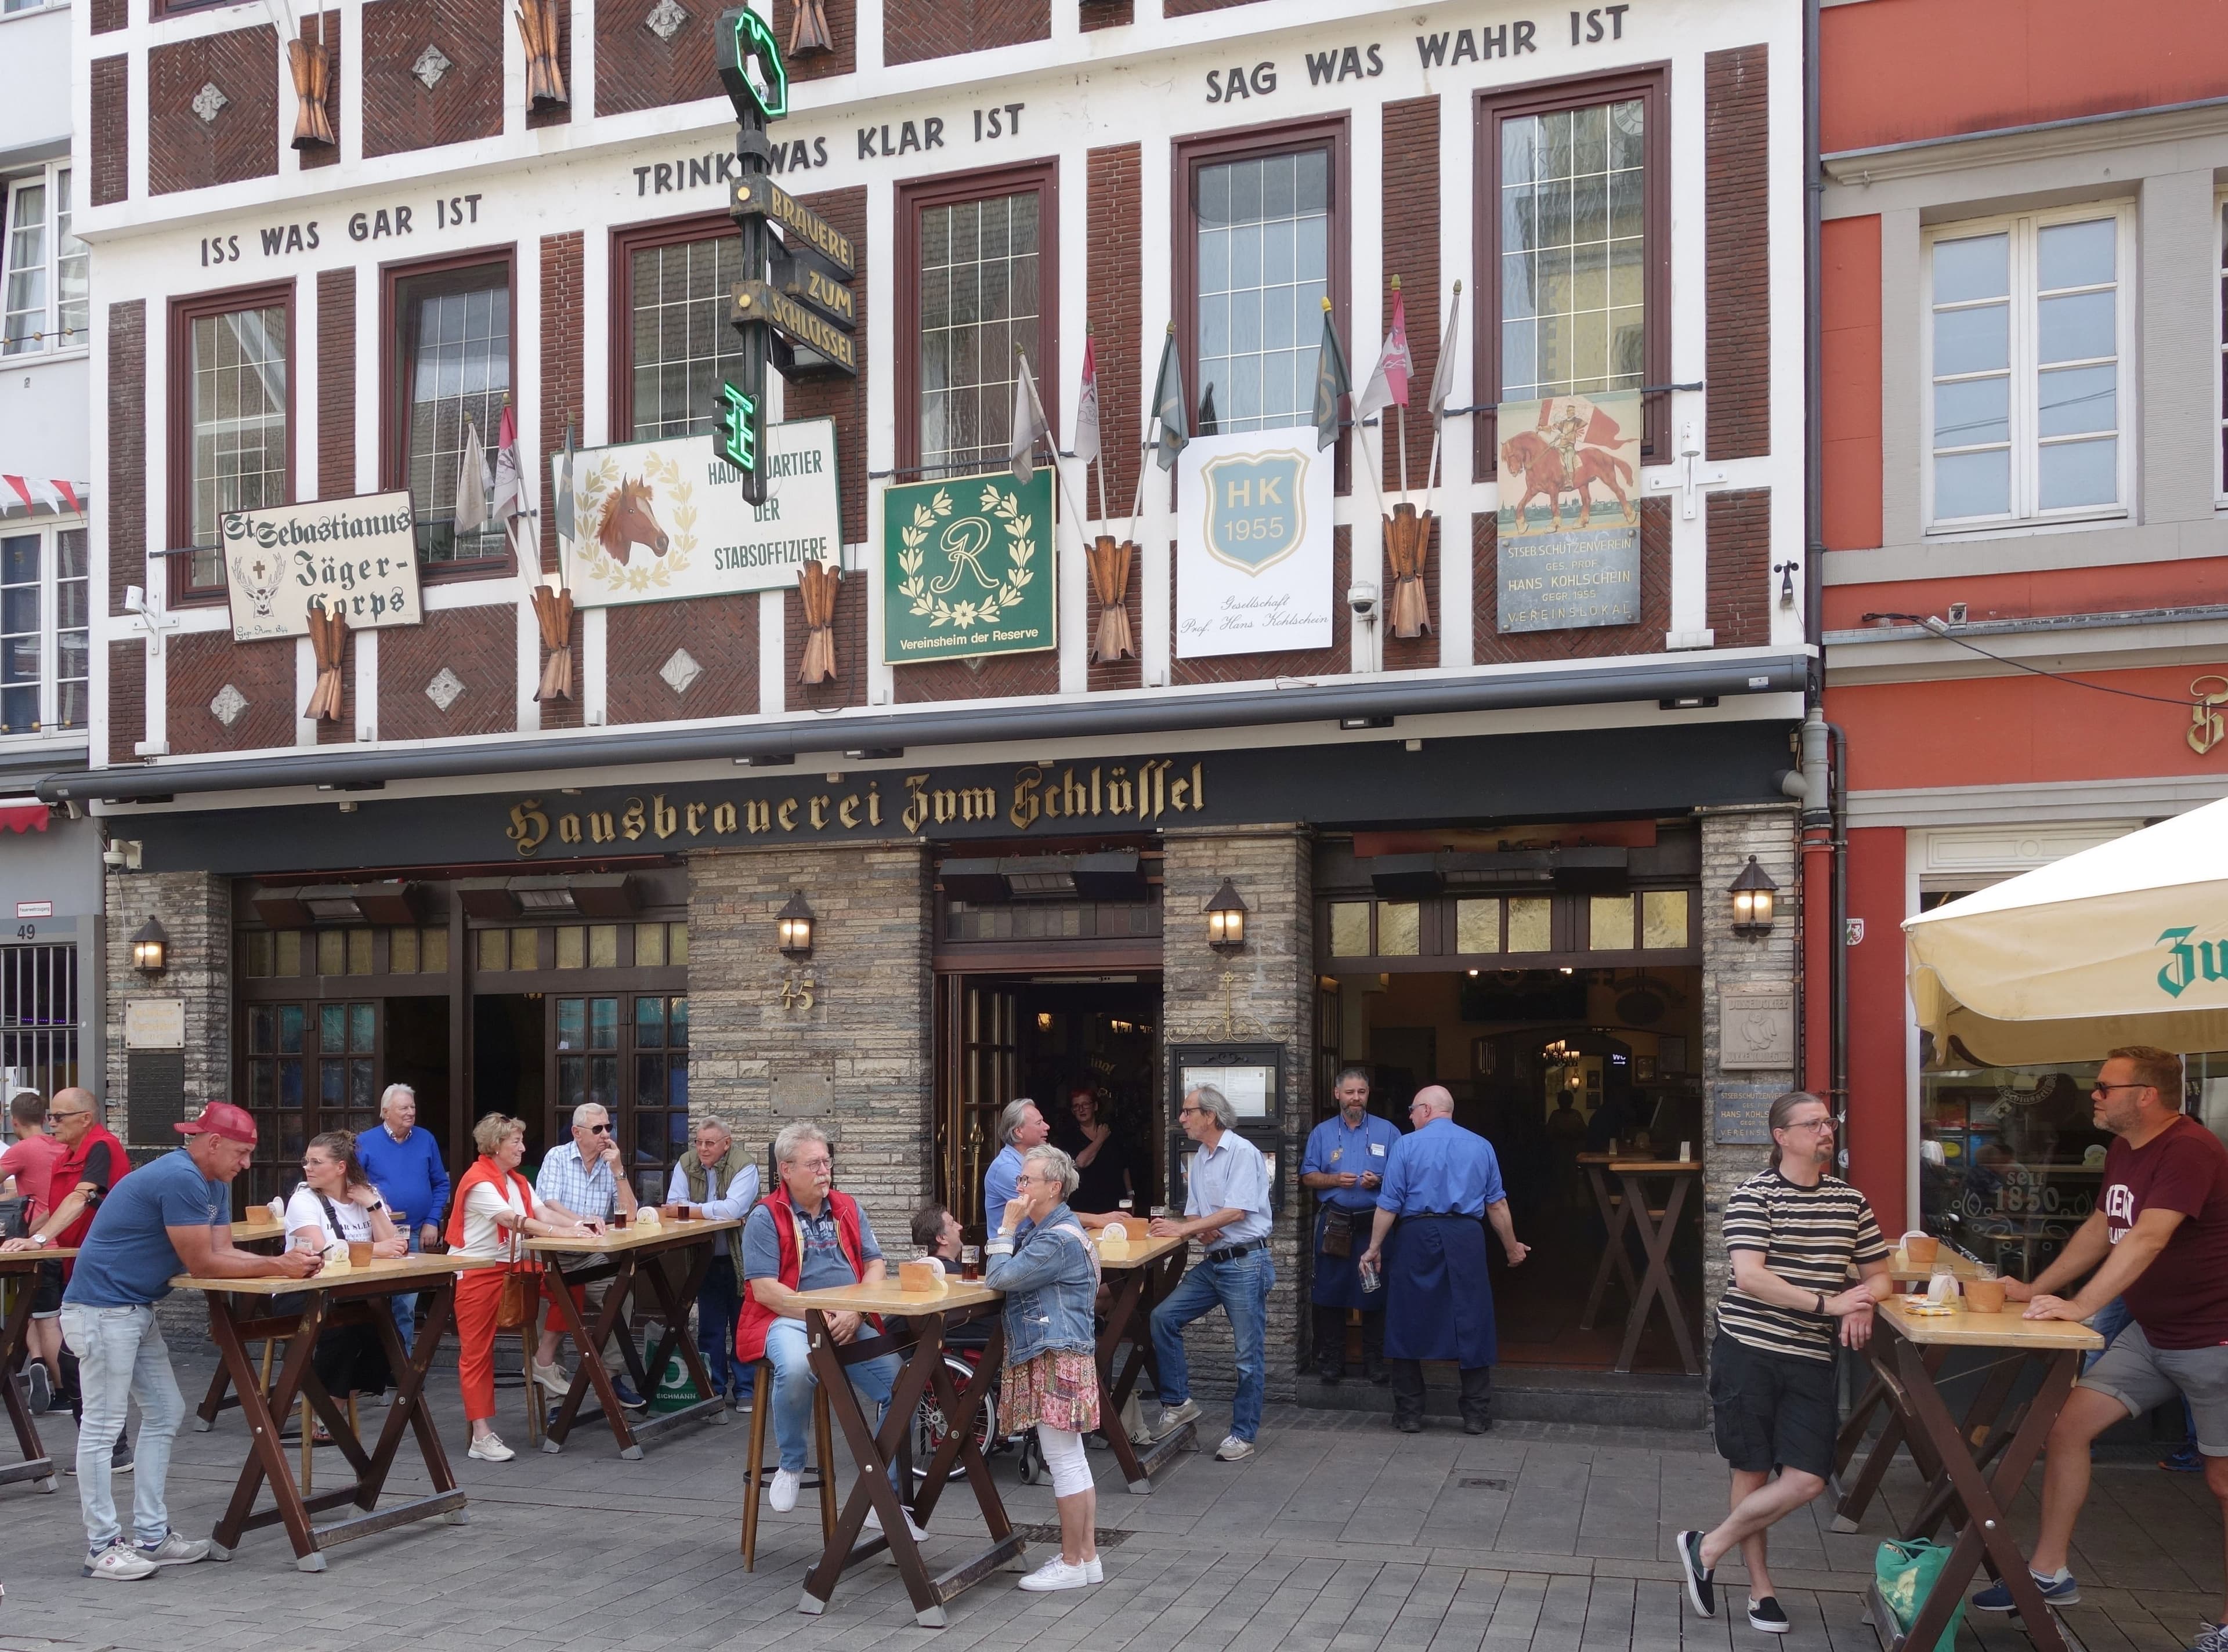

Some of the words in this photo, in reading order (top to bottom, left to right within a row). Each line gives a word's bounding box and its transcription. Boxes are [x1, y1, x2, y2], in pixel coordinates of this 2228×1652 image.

[1206, 61, 1276, 103] SAG
[1305, 44, 1384, 85] WAS
[1416, 20, 1537, 68] WAHR
[1570, 4, 1629, 46] IST
[633, 152, 736, 196] TRINK
[768, 136, 828, 174] WAS
[858, 117, 943, 160] KLAR
[973, 103, 1025, 142] IST
[201, 234, 241, 267] ISS
[261, 221, 320, 256] WAS
[348, 205, 413, 241] GAR
[436, 194, 482, 229] IST
[771, 186, 855, 271] BRAUEREI
[808, 270, 852, 318] ZUM
[772, 292, 855, 368] SCHLÜSSEL
[754, 497, 781, 523] DER
[255, 505, 412, 549] Sebastianus
[1224, 516, 1285, 542] 1955
[714, 536, 828, 571] STABSOFFIZIERE
[1509, 577, 1542, 591] HANS
[1551, 570, 1630, 588] KOHLSCHEIN
[1573, 590, 1596, 599] 1955
[306, 586, 405, 623] Corps
[1220, 593, 1291, 611] Gesellschaft
[1508, 603, 1632, 622] VEREINSLOKAL
[900, 634, 967, 650] Vereinsheim
[971, 632, 989, 644] der
[993, 628, 1039, 642] Reserve
[1180, 618, 1213, 637] Prof.
[1220, 615, 1254, 631] Hans
[1262, 610, 1329, 628] Kohlschein
[505, 780, 884, 857] Hausbrauerei
[902, 773, 997, 835] Zum
[17, 923, 35, 940] 49
[779, 979, 815, 1010] 45
[1995, 1186, 2060, 1212] 1850
